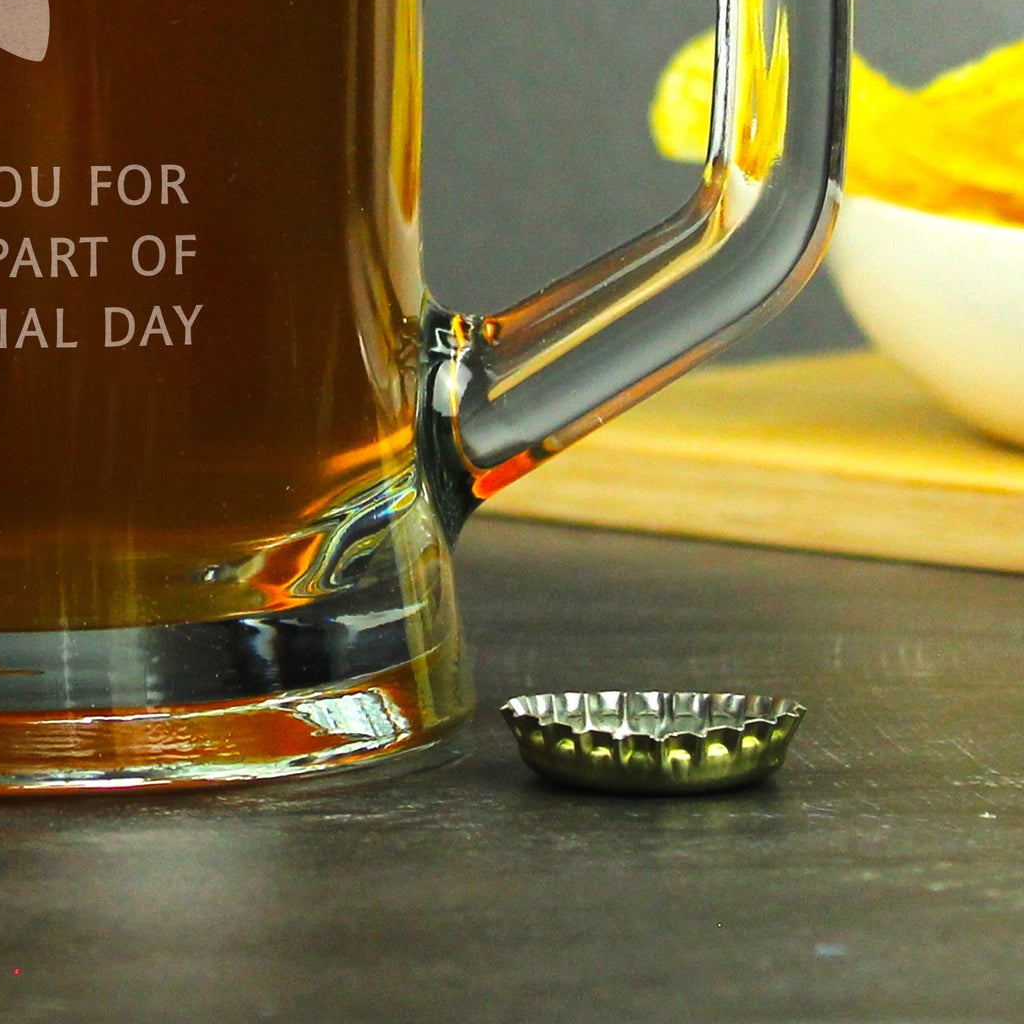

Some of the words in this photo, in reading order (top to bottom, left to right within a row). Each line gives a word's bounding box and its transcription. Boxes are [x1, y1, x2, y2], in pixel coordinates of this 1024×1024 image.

[90, 164, 190, 205] FOR
[132, 234, 197, 276] OF
[104, 304, 204, 348] DAY
